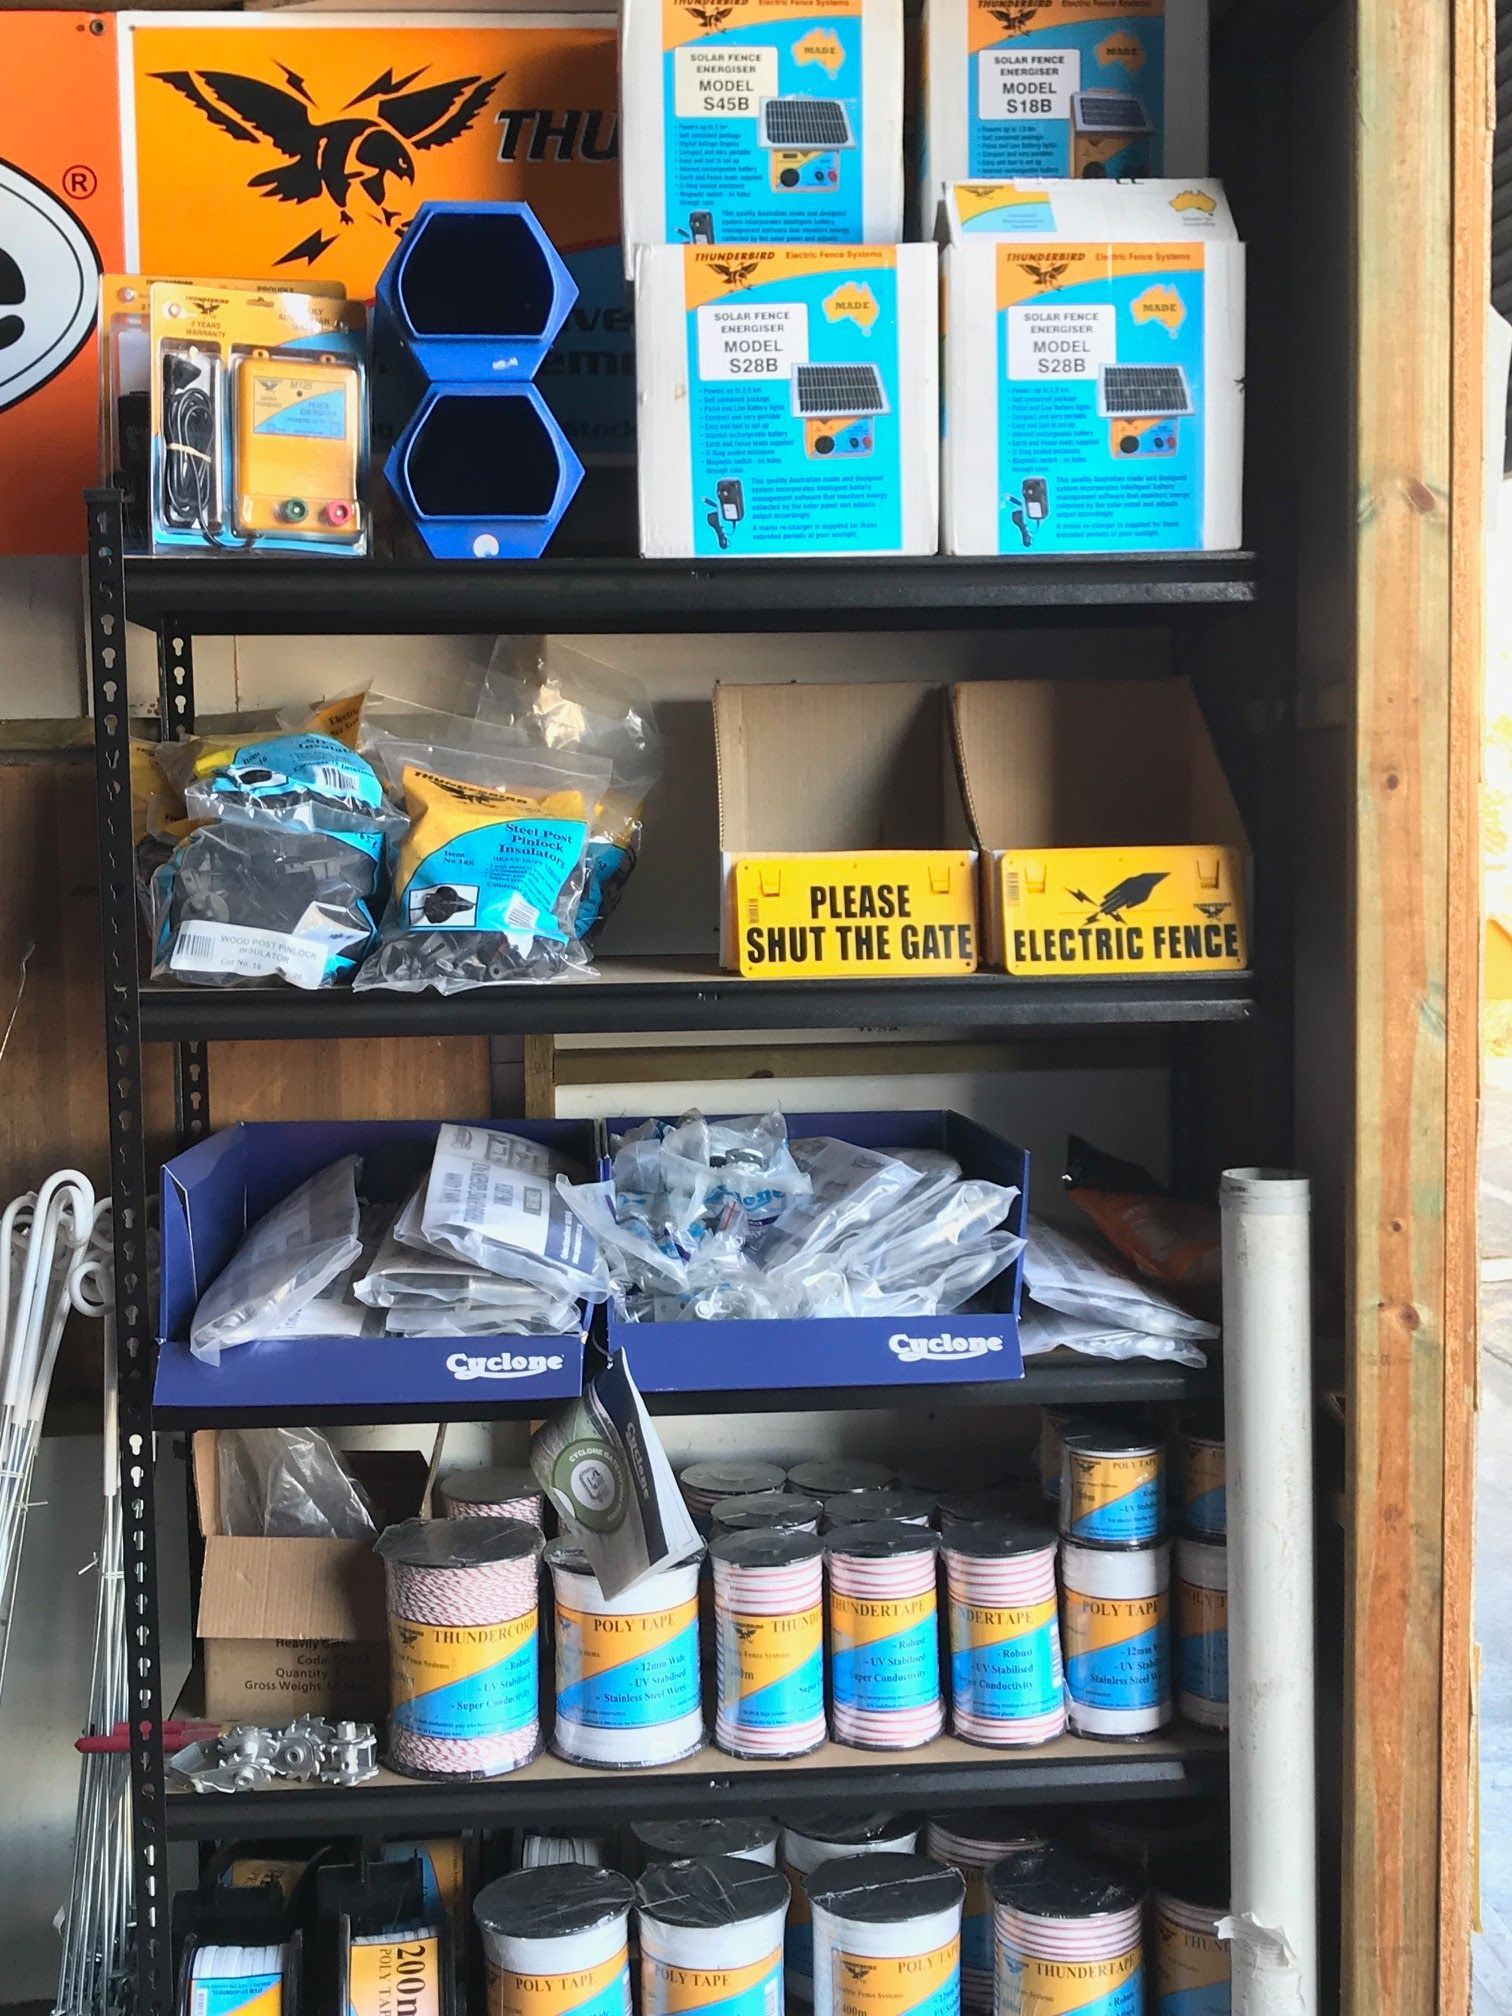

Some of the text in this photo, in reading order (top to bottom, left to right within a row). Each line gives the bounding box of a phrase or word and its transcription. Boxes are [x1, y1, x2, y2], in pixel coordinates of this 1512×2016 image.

[690, 54, 762, 62] SOLAR FENCE
[994, 56, 1065, 65] SOLAR FENCE
[696, 66, 756, 74] ENERGISER
[1000, 67, 1059, 77] ENERGISER
[699, 80, 754, 92] MODEL
[1002, 82, 1057, 95] MODEL
[704, 97, 750, 111] S45B
[1006, 99, 1052, 114] S18B
[695, 250, 883, 261] THUNDERBIRD Electric Fence Systems
[1006, 253, 1086, 261] THUNDERBIRD
[1129, 253, 1153, 261] Fence
[1155, 252, 1190, 262] Systems
[714, 311, 791, 322] SOLAR FENCE
[1024, 312, 1099, 321] SOLAR FENCE
[721, 324, 785, 334] ENERGISER
[1030, 325, 1093, 334] ENERGISER
[724, 339, 783, 353] MODEL
[1033, 341, 1091, 352] MODEL
[730, 358, 778, 373] S28B
[1038, 359, 1086, 373] S28B
[505, 823, 572, 844] Steel Post
[512, 834, 564, 852] Pinlock
[809, 884, 912, 920] PLEASE
[221, 935, 317, 959] WOOD POST PINLOCK
[746, 923, 974, 964] SHUT THE GATE
[1014, 923, 1239, 962] ELECTRIC FENCE
[239, 947, 290, 963] INSULATOR
[888, 1332, 1004, 1362] Cyclone
[446, 1351, 564, 1383] Cyclone
[569, 1447, 603, 1462] CYCLONE
[625, 1421, 650, 1500] Cyclone
[1083, 1602, 1122, 1616] POLY
[594, 1614, 676, 1633] POLY TAPE
[871, 1653, 926, 1666] UV Stabilised
[1003, 1649, 1033, 1658] Robust
[992, 1663, 1033, 1673] Stabilised
[635, 1678, 649, 1687] UV
[874, 1669, 926, 1683] Conductivity
[1090, 1673, 1127, 1685] Stainless
[245, 1681, 276, 1690] Gross
[979, 1680, 1033, 1690] Conductivity
[604, 1693, 643, 1703] Stainless
[644, 1690, 666, 1701] Steel
[456, 1700, 483, 1711] Super
[378, 1948, 392, 1980] POLY
[898, 1957, 933, 1974] POLY
[1035, 1953, 1136, 1980] THUNDERTAPE
[515, 1971, 597, 1993] POLY TAPE
[691, 1973, 731, 1987] TAPE
